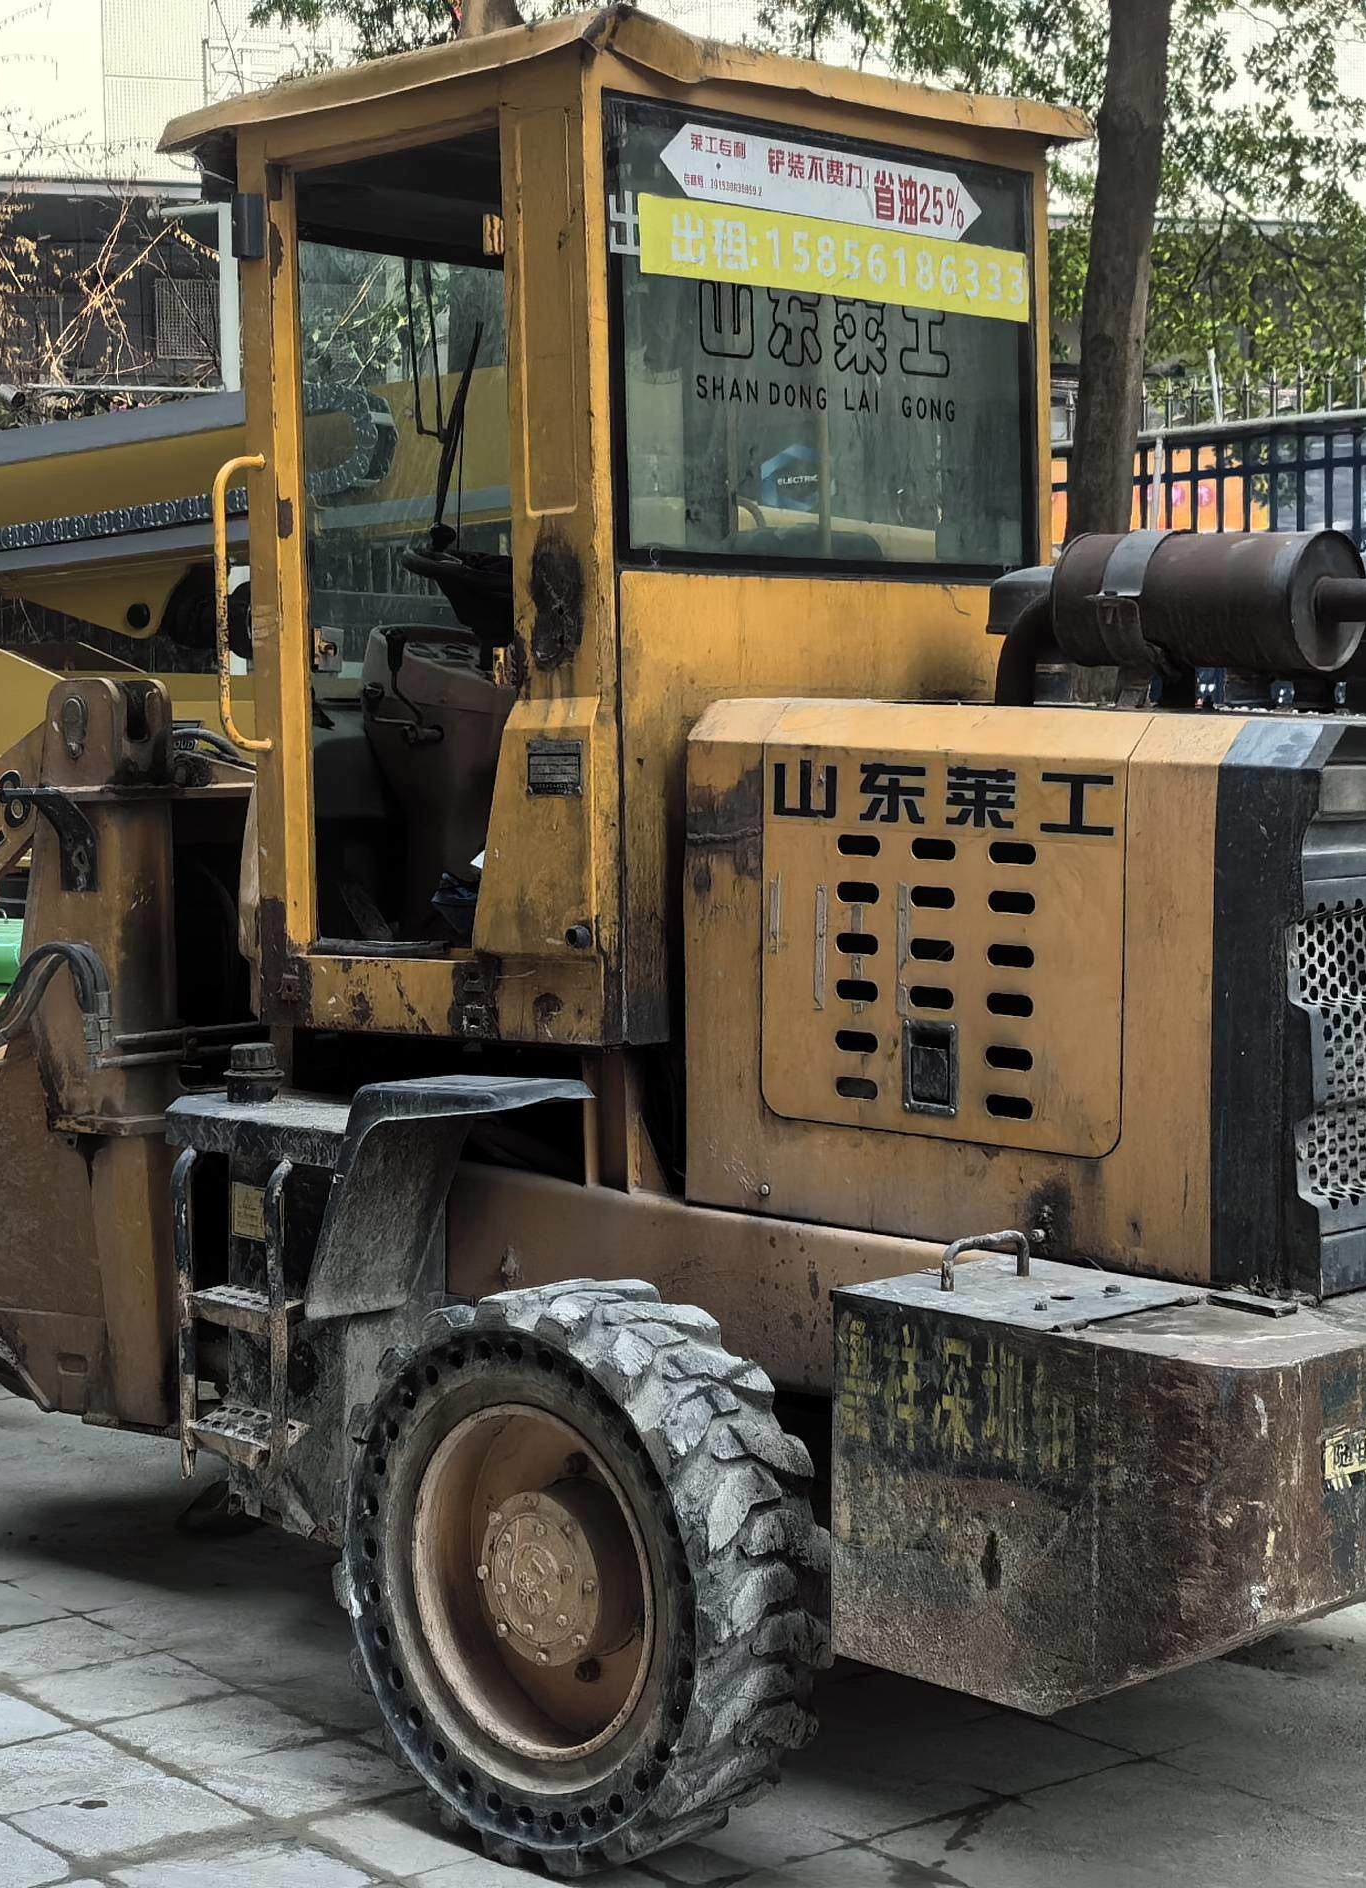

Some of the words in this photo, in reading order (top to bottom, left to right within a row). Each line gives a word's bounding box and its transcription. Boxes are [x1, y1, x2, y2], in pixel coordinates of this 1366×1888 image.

[690, 132, 747, 160] 莱工专利
[767, 147, 863, 190] 铲装不费力
[874, 169, 964, 229] 省油25%
[698, 278, 951, 378] 山东莱工
[696, 374, 759, 405] SHAN
[769, 382, 828, 411] DONG
[844, 387, 879, 414] LAI
[901, 396, 956, 423] GONG
[773, 759, 1115, 837] 山东莱工
